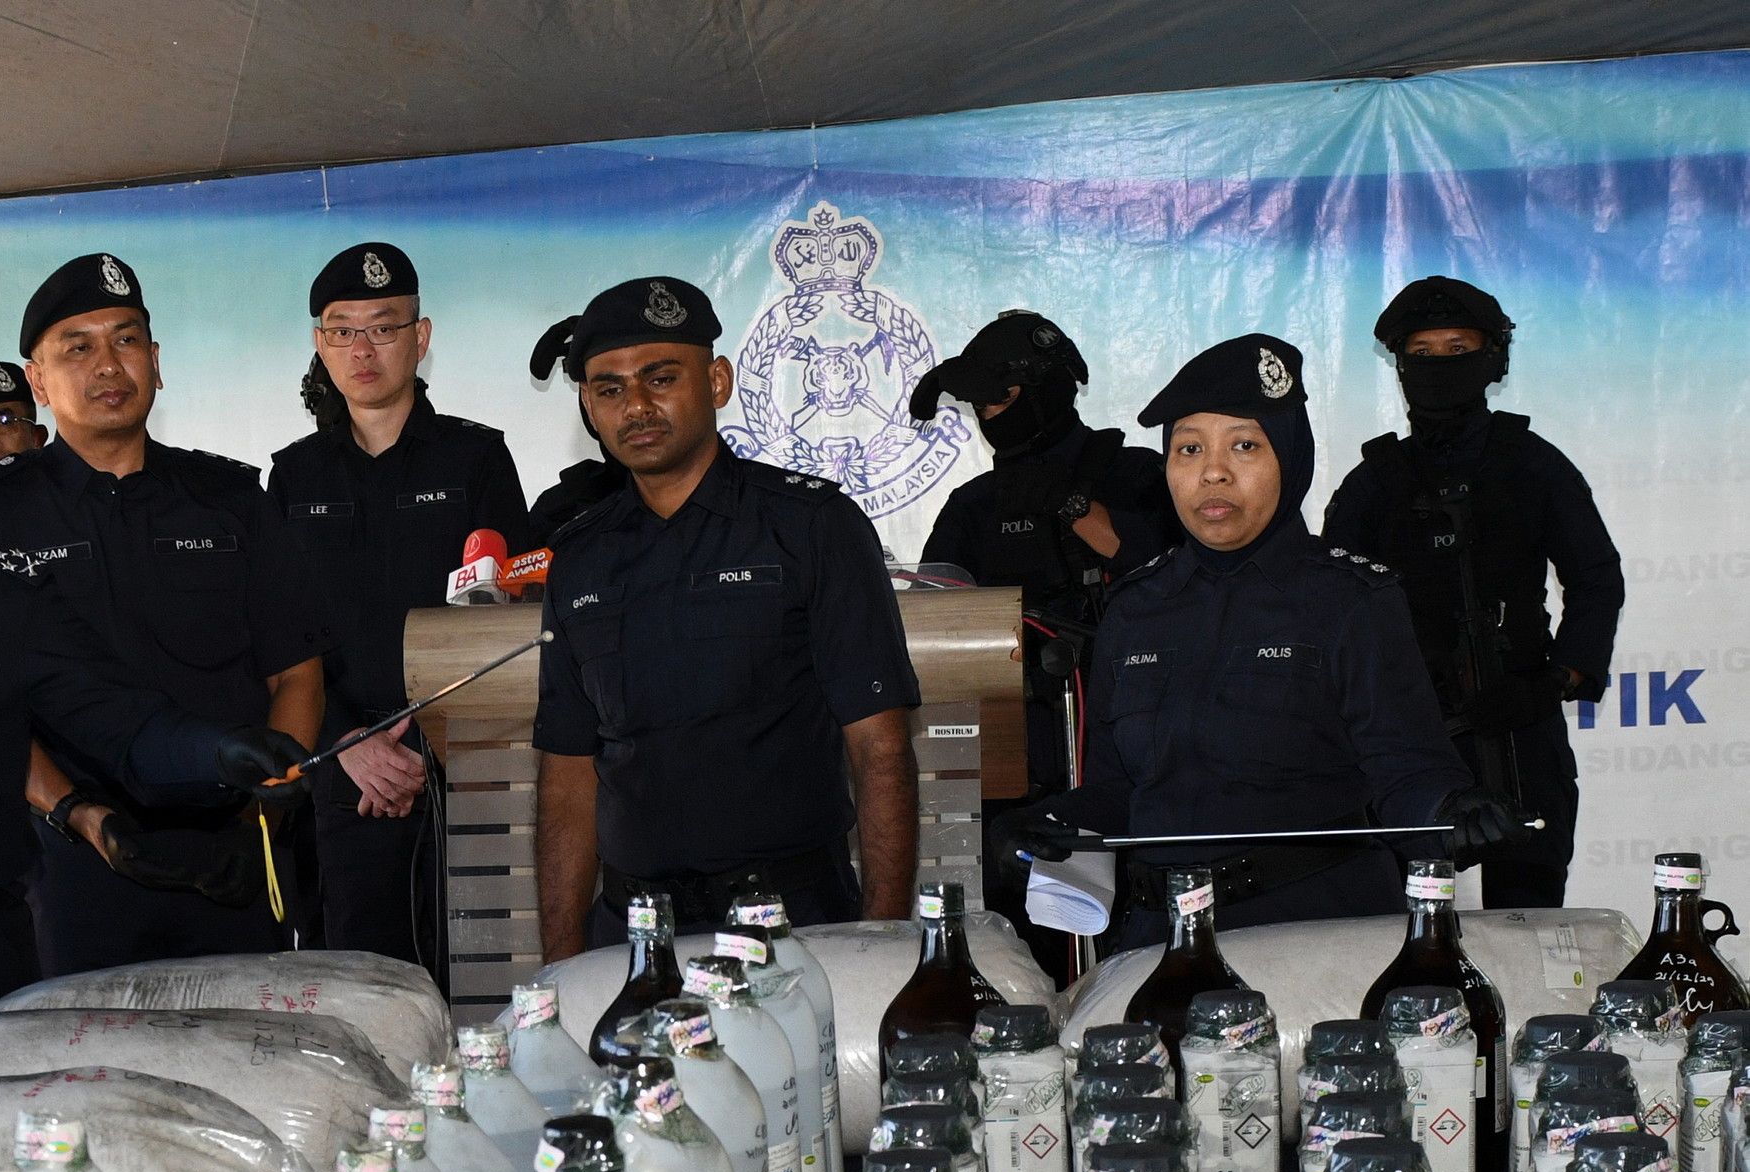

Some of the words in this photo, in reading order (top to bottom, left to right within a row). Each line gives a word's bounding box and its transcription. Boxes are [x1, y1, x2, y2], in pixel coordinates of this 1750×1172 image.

[862, 450, 950, 512] MALAYSIA
[415, 491, 447, 503] POLIS
[310, 505, 329, 514] LEE
[1001, 520, 1034, 533] POLIS
[175, 539, 214, 550] POLIS
[512, 552, 546, 568] astro
[506, 560, 548, 579] AWANI
[1628, 552, 1750, 583] DANG
[718, 571, 752, 582] POLIS
[572, 593, 600, 609] GOPAL
[1257, 647, 1292, 658] POLIS
[1585, 741, 1750, 774] SIDANG
